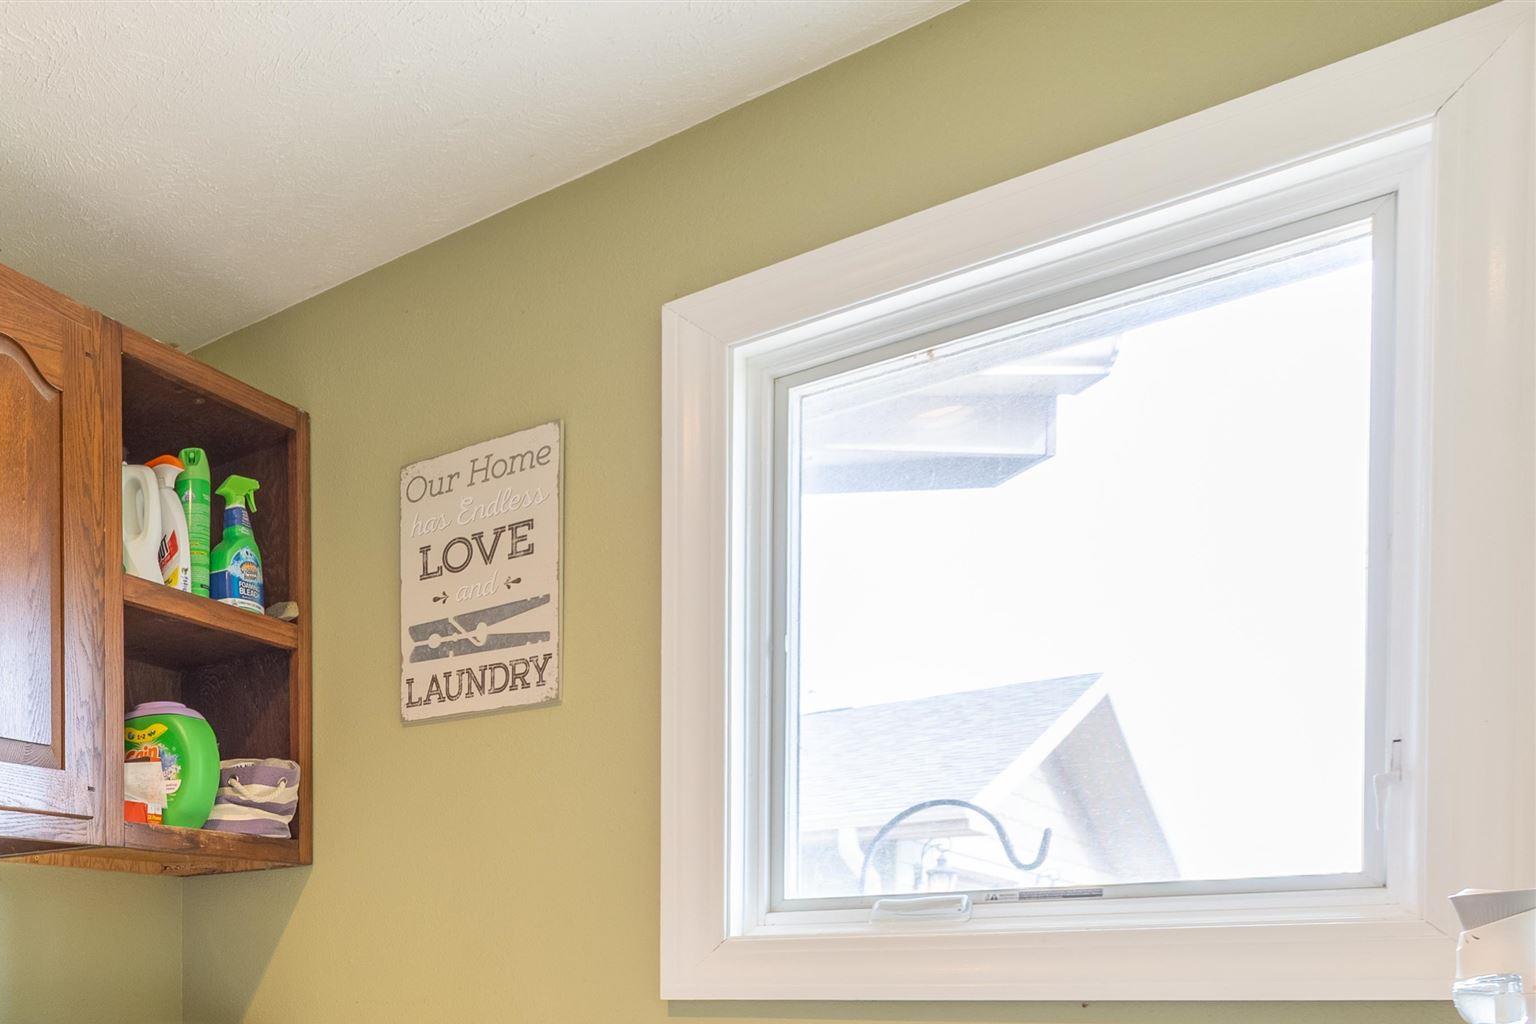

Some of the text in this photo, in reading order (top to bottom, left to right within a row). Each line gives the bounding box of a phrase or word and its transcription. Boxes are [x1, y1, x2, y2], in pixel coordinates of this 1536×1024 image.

[405, 445, 552, 503] Our Home
[410, 487, 550, 538] has Endless
[419, 518, 534, 581] LOVE
[455, 569, 499, 601] and
[405, 653, 553, 709] LAUNDRY
